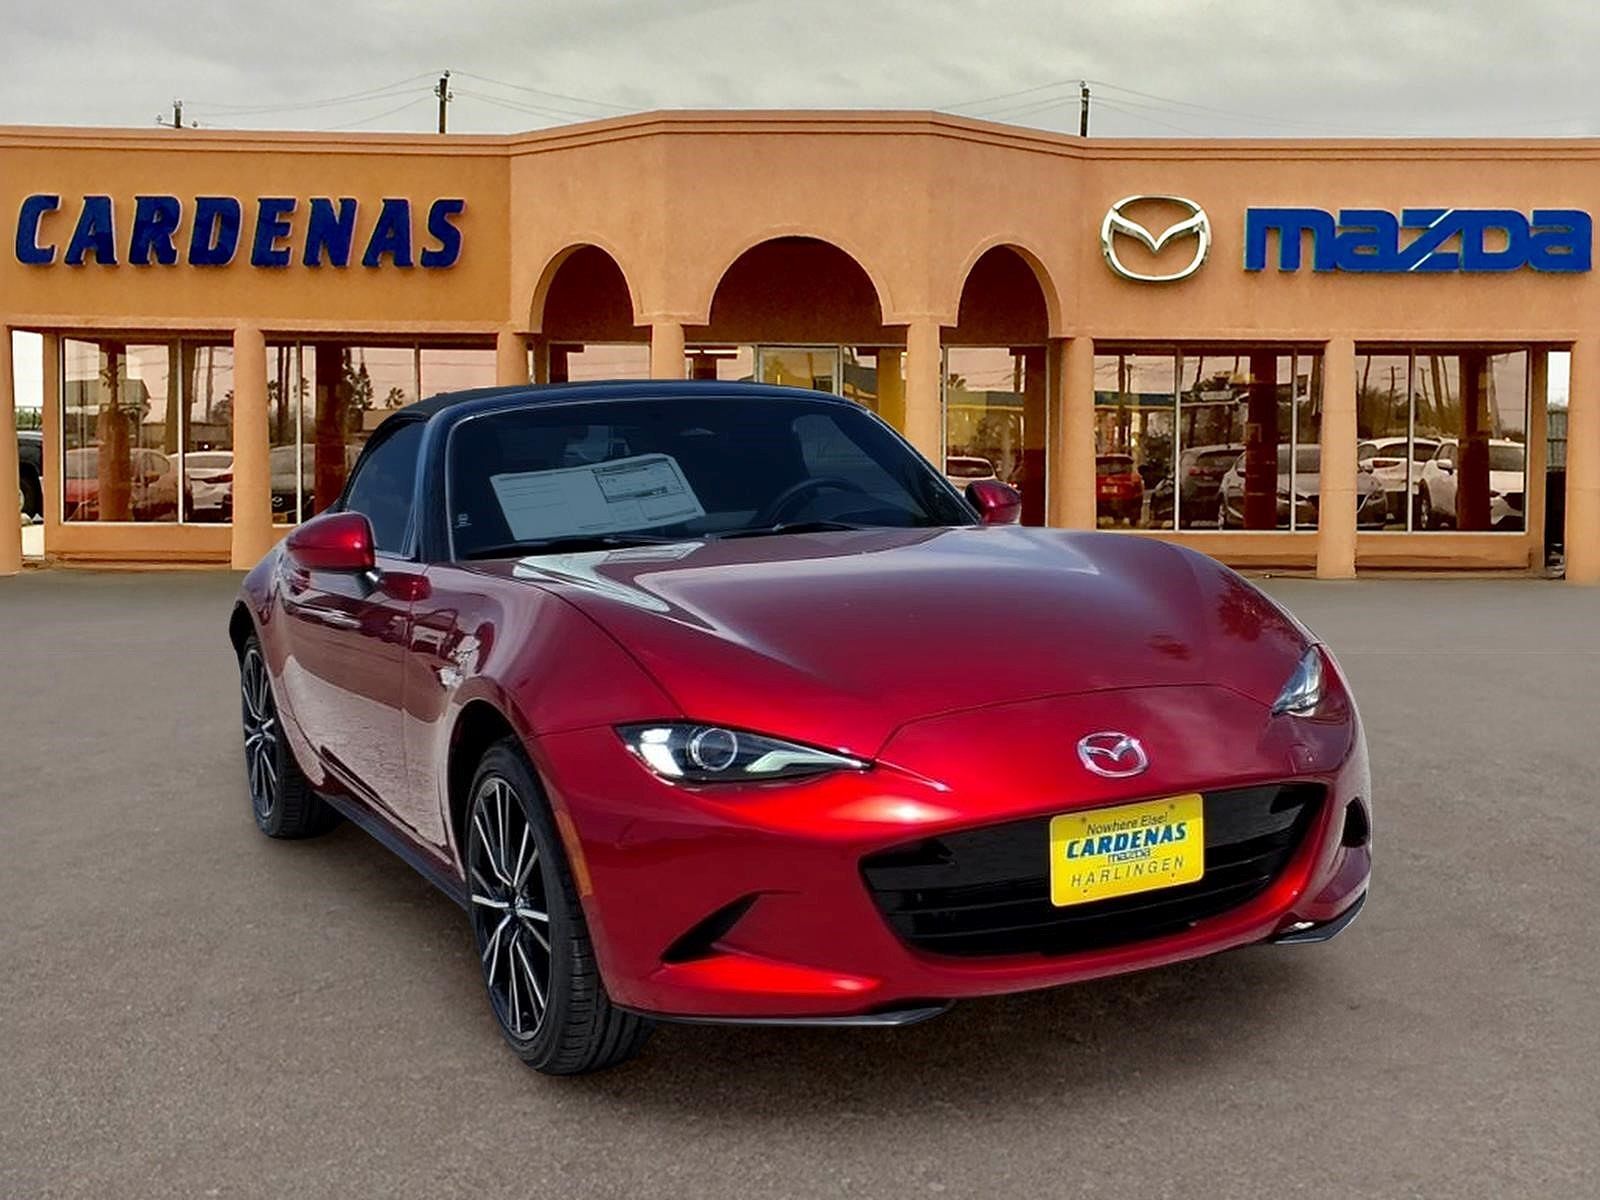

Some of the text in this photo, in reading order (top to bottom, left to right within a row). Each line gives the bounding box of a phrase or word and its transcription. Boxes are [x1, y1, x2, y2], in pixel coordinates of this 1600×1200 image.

[15, 194, 468, 268] CARDENAS
[1066, 822, 1187, 859] CARDENAS
[1087, 811, 1170, 836] Nowhere Else!
[1071, 855, 1185, 888] HARLINGEN
